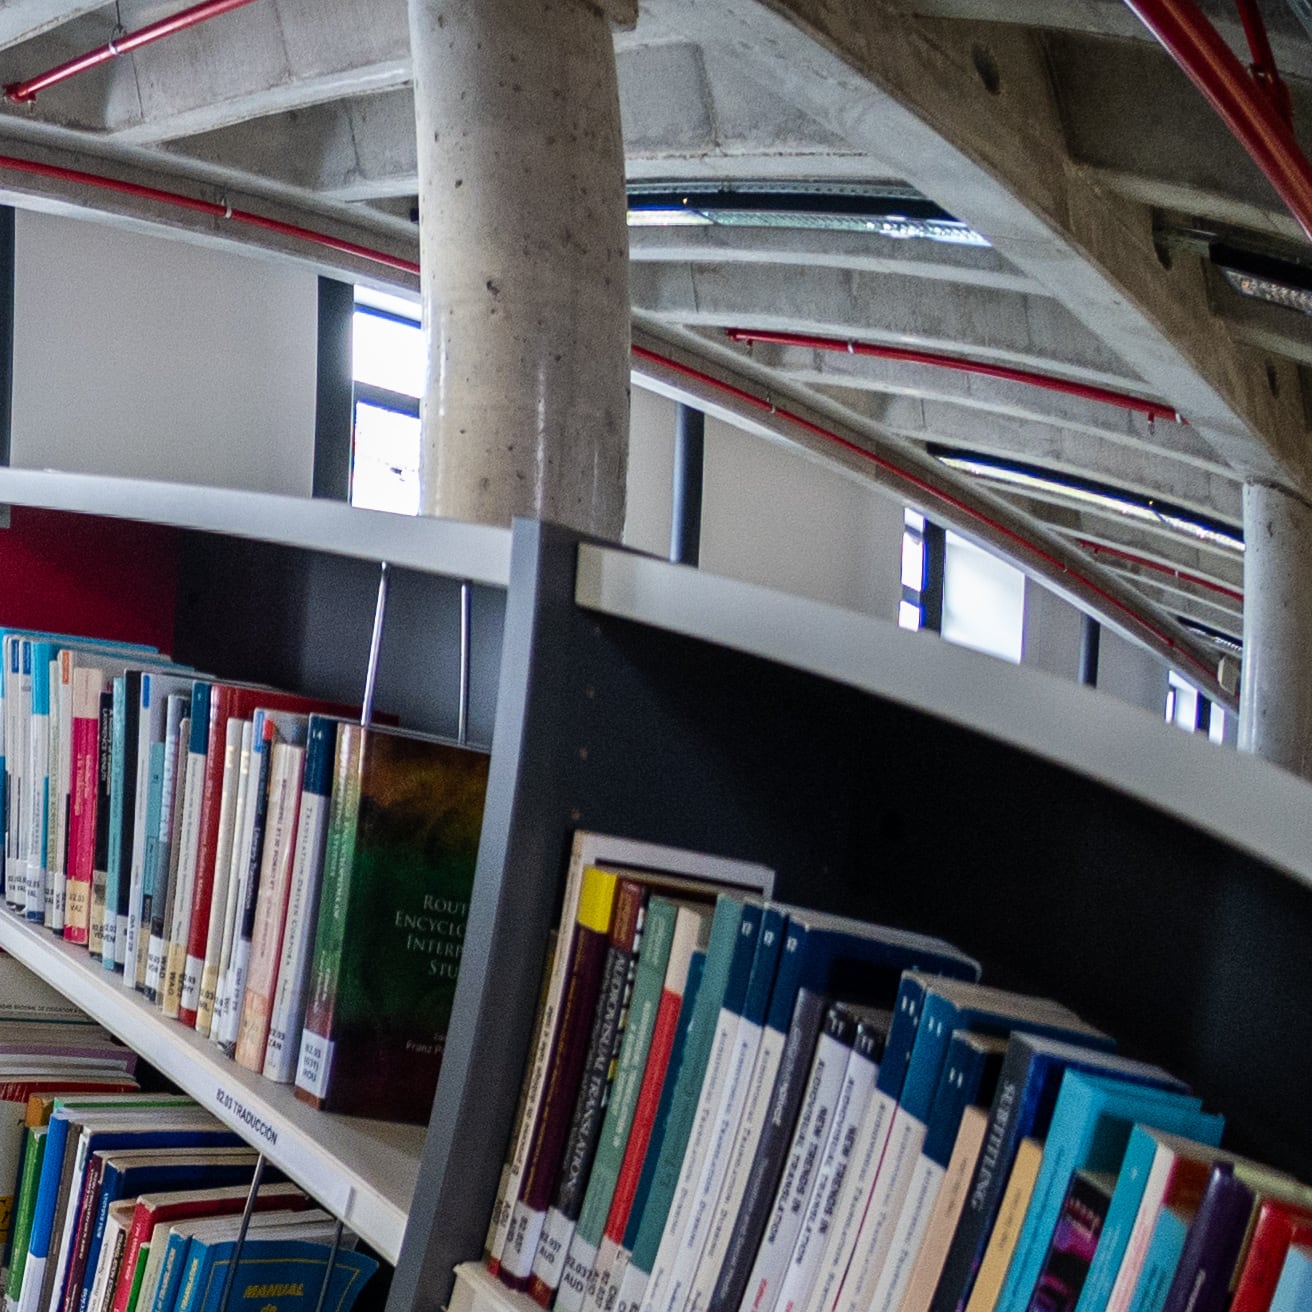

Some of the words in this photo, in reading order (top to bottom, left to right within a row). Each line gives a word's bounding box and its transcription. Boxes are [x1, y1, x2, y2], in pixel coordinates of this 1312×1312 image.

[592, 953, 626, 1072] AUDIOVISUAL
[229, 1099, 281, 1147] TRADUCCIÓN
[565, 1072, 600, 1190] TRANSLATION
[809, 1105, 830, 1138] NEW
[838, 1123, 858, 1157] NEW
[969, 1079, 1018, 1212] SUBTITLING
[791, 1141, 820, 1194] TRENDS
[821, 1160, 848, 1215] TRENDS
[766, 1151, 801, 1246] TRANSLATION
[786, 1195, 801, 1214] IN
[816, 1217, 830, 1235] IN
[243, 1280, 304, 1300] MANUAL
